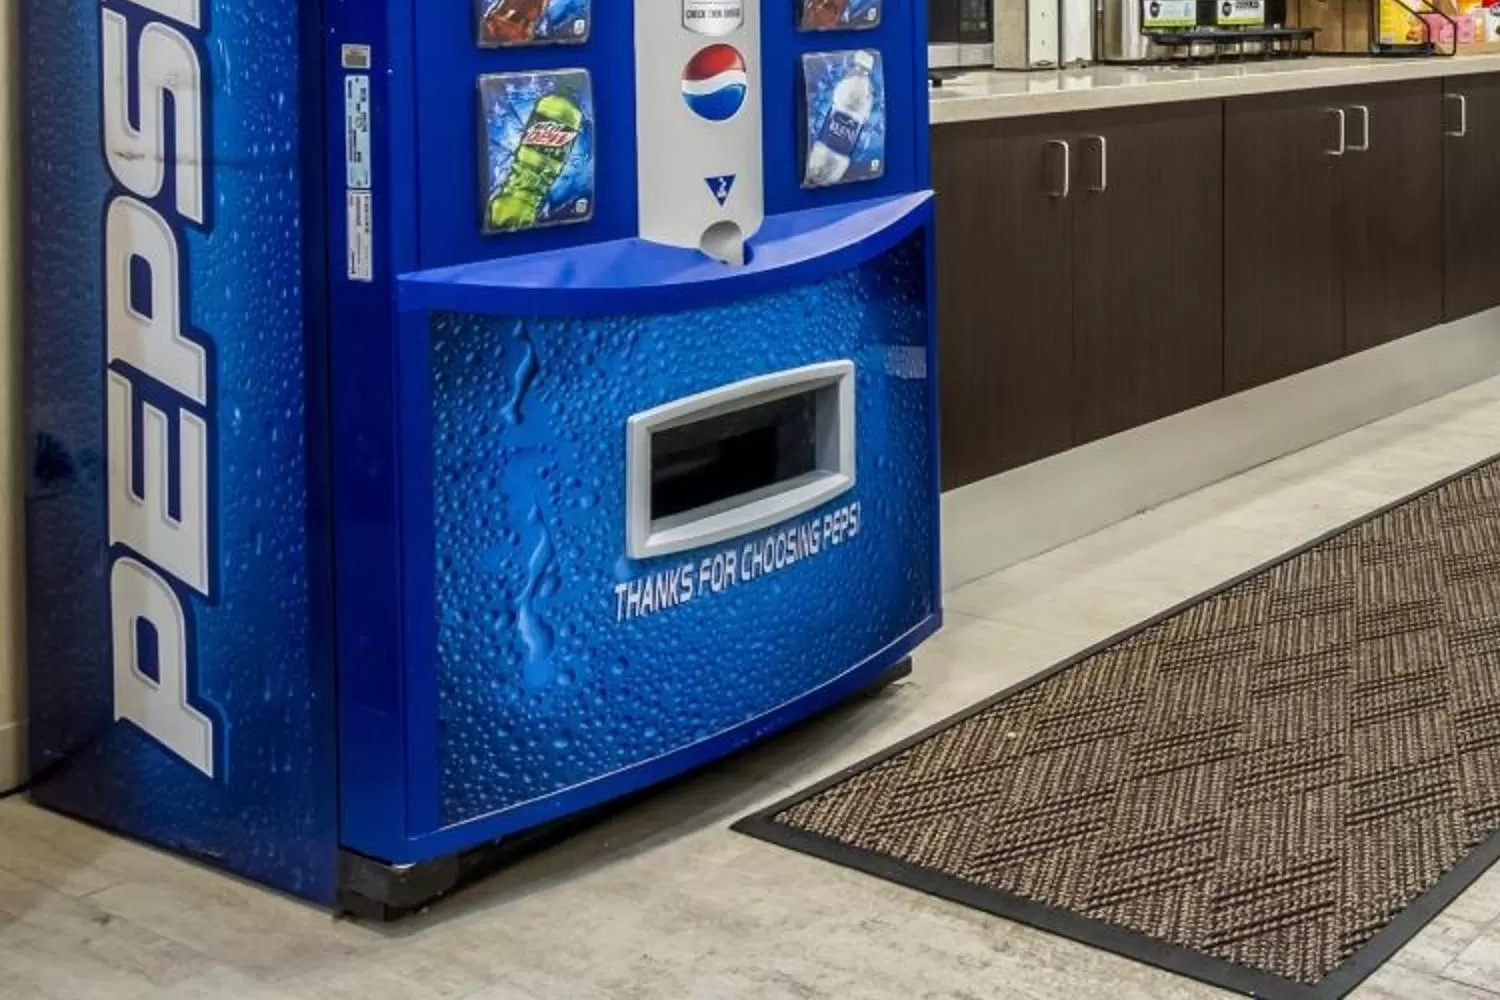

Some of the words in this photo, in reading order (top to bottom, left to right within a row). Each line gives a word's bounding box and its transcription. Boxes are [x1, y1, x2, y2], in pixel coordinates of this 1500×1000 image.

[614, 563, 695, 624] THANKS
[699, 550, 737, 593] FOR
[741, 518, 821, 581] CHOOSING
[823, 501, 862, 546] PEPSI
